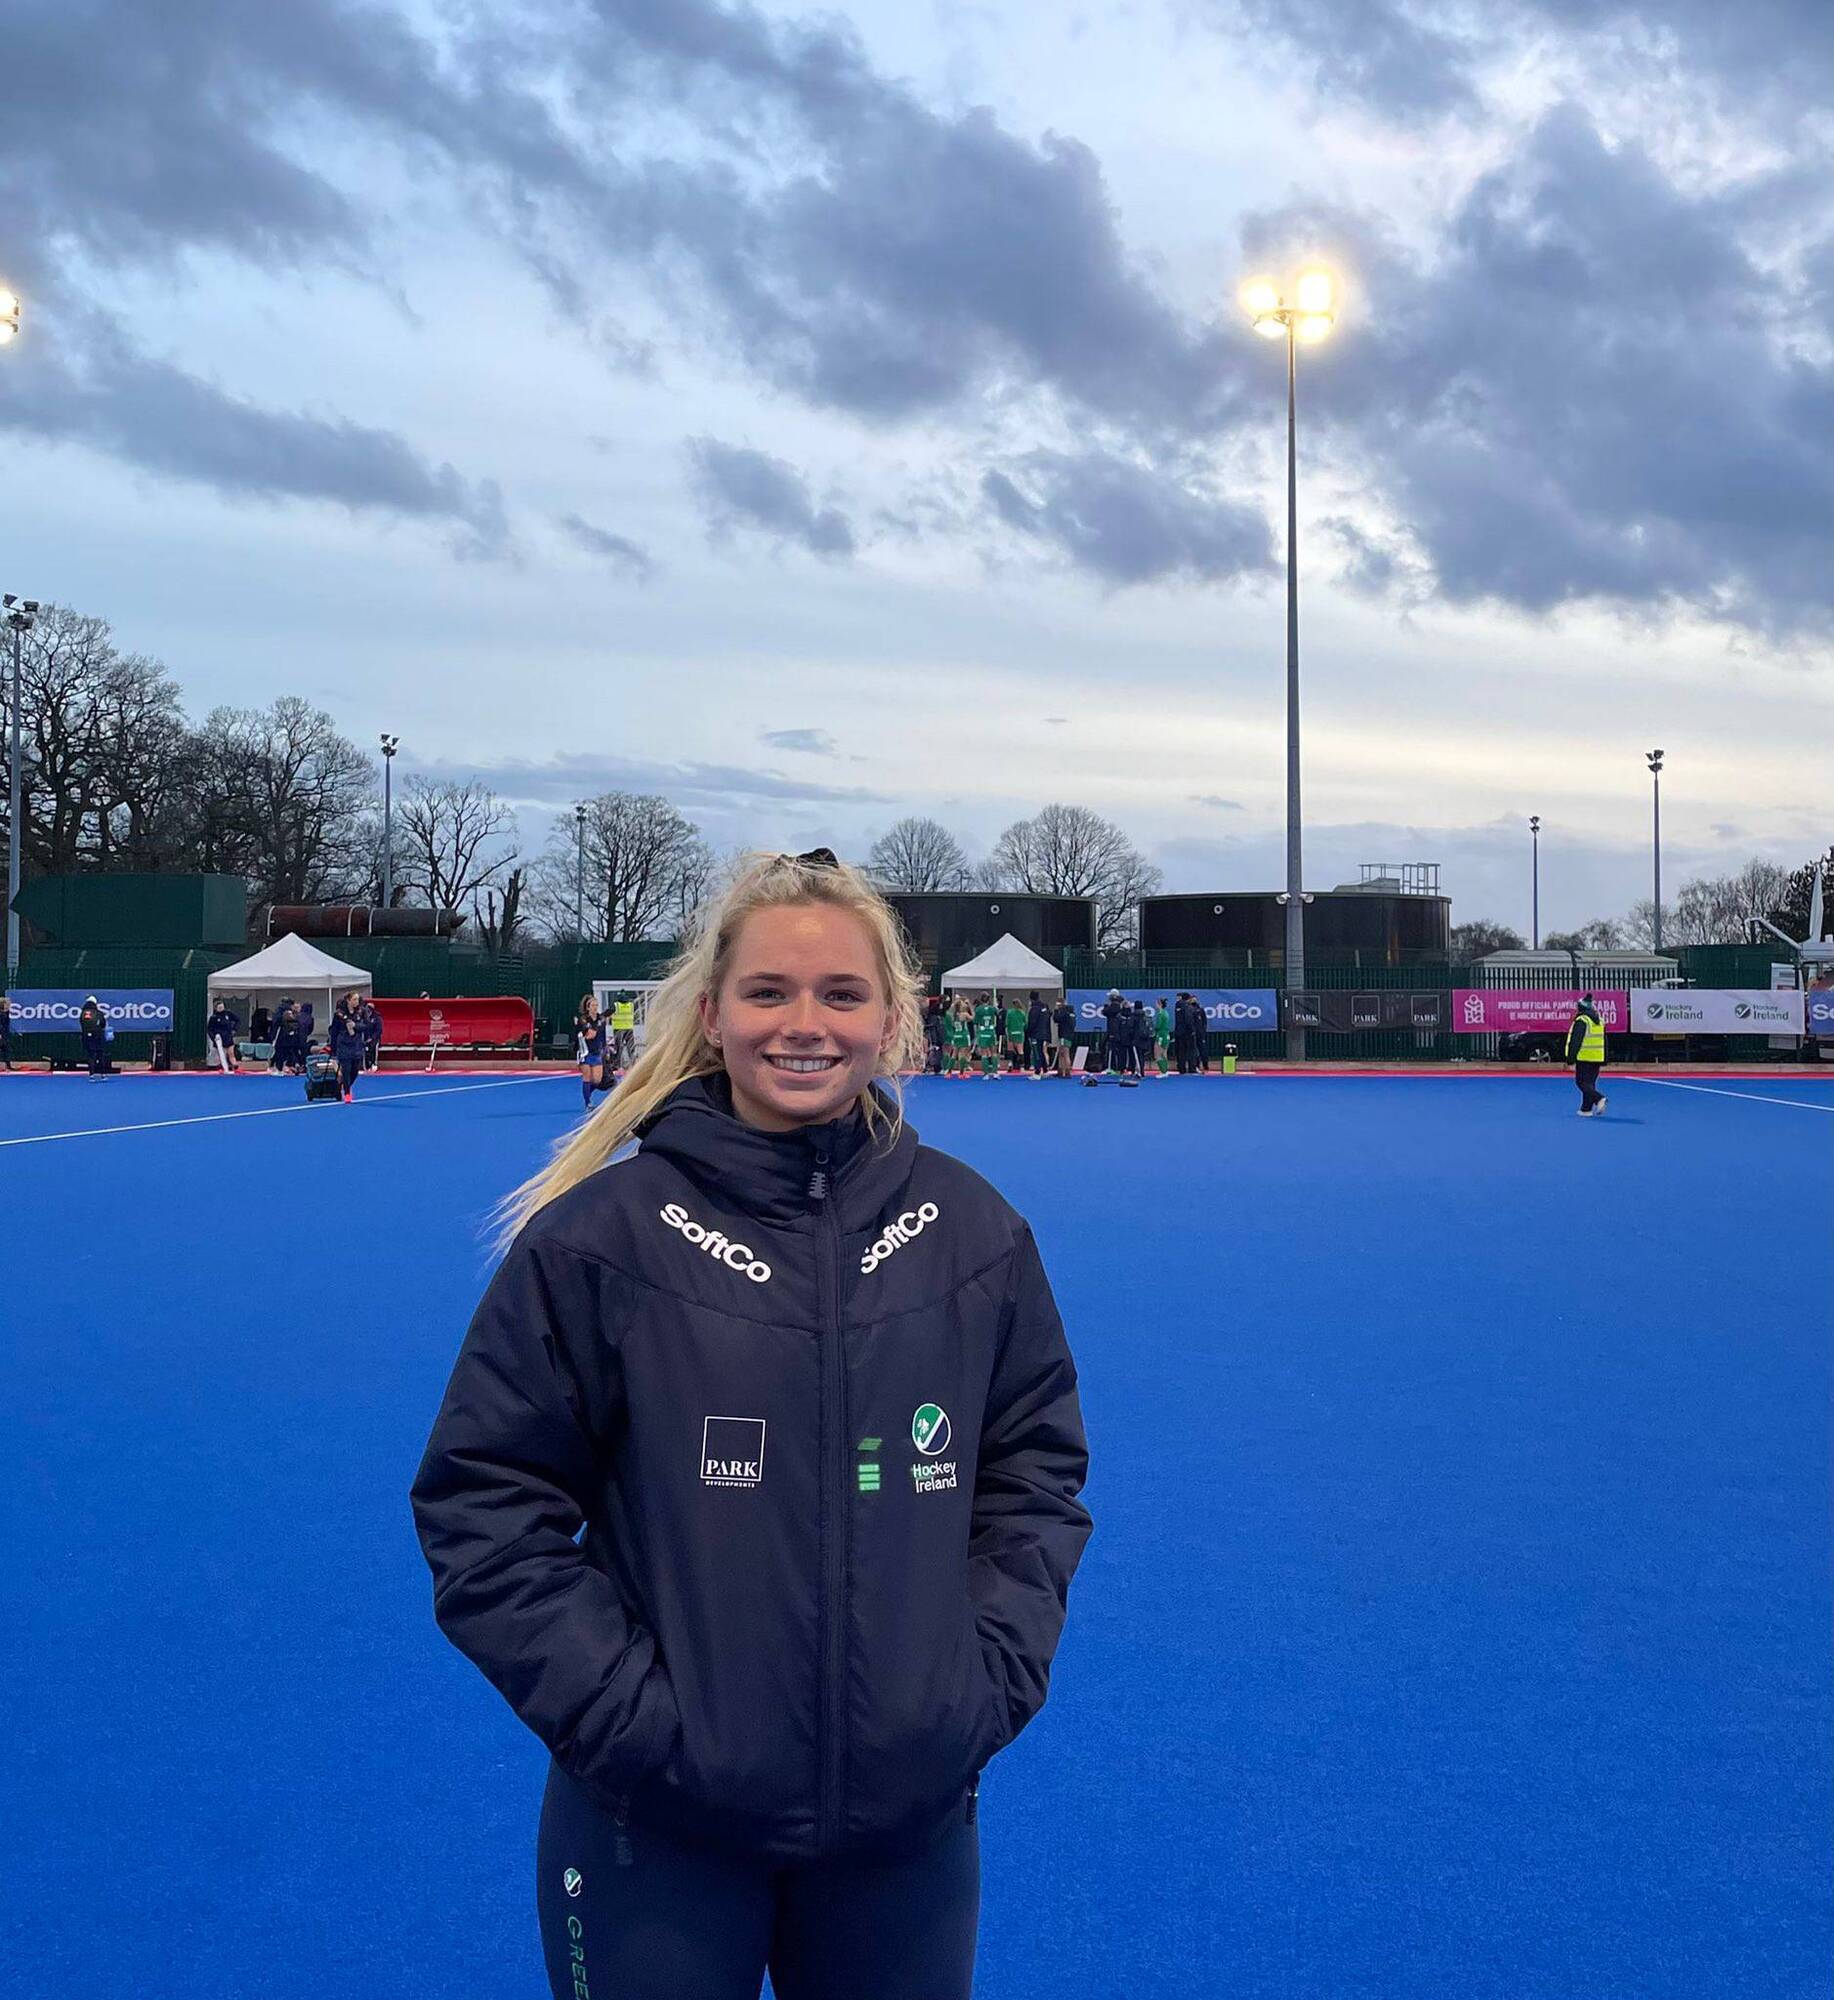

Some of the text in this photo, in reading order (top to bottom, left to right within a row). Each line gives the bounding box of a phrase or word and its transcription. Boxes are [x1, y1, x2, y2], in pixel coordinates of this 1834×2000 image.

[8, 1002, 82, 1019] SoftCo
[97, 1002, 170, 1019] SoftCo
[1498, 1001, 1521, 1009] PROUD
[1522, 1001, 1551, 1009] OFFICIAL
[1592, 1000, 1617, 1012] SABA
[1665, 1004, 1692, 1012] Hockey
[1753, 1004, 1778, 1012] Hockey
[1205, 1003, 1261, 1019] oftCo
[1517, 1012, 1543, 1020] HOCKEY
[1544, 1012, 1571, 1020] IRELAND
[1665, 1010, 1703, 1020] Ireland
[1753, 1010, 1789, 1020] Ireland
[1295, 1014, 1318, 1022] PARK
[1354, 1014, 1377, 1023] PARK
[1414, 1014, 1437, 1022] PARK
[660, 1203, 771, 1283] SoftCo
[861, 1202, 939, 1274] SoftCo
[706, 1460, 758, 1477] PARK
[913, 1461, 957, 1478] Hockey
[915, 1475, 958, 1493] Ireland
